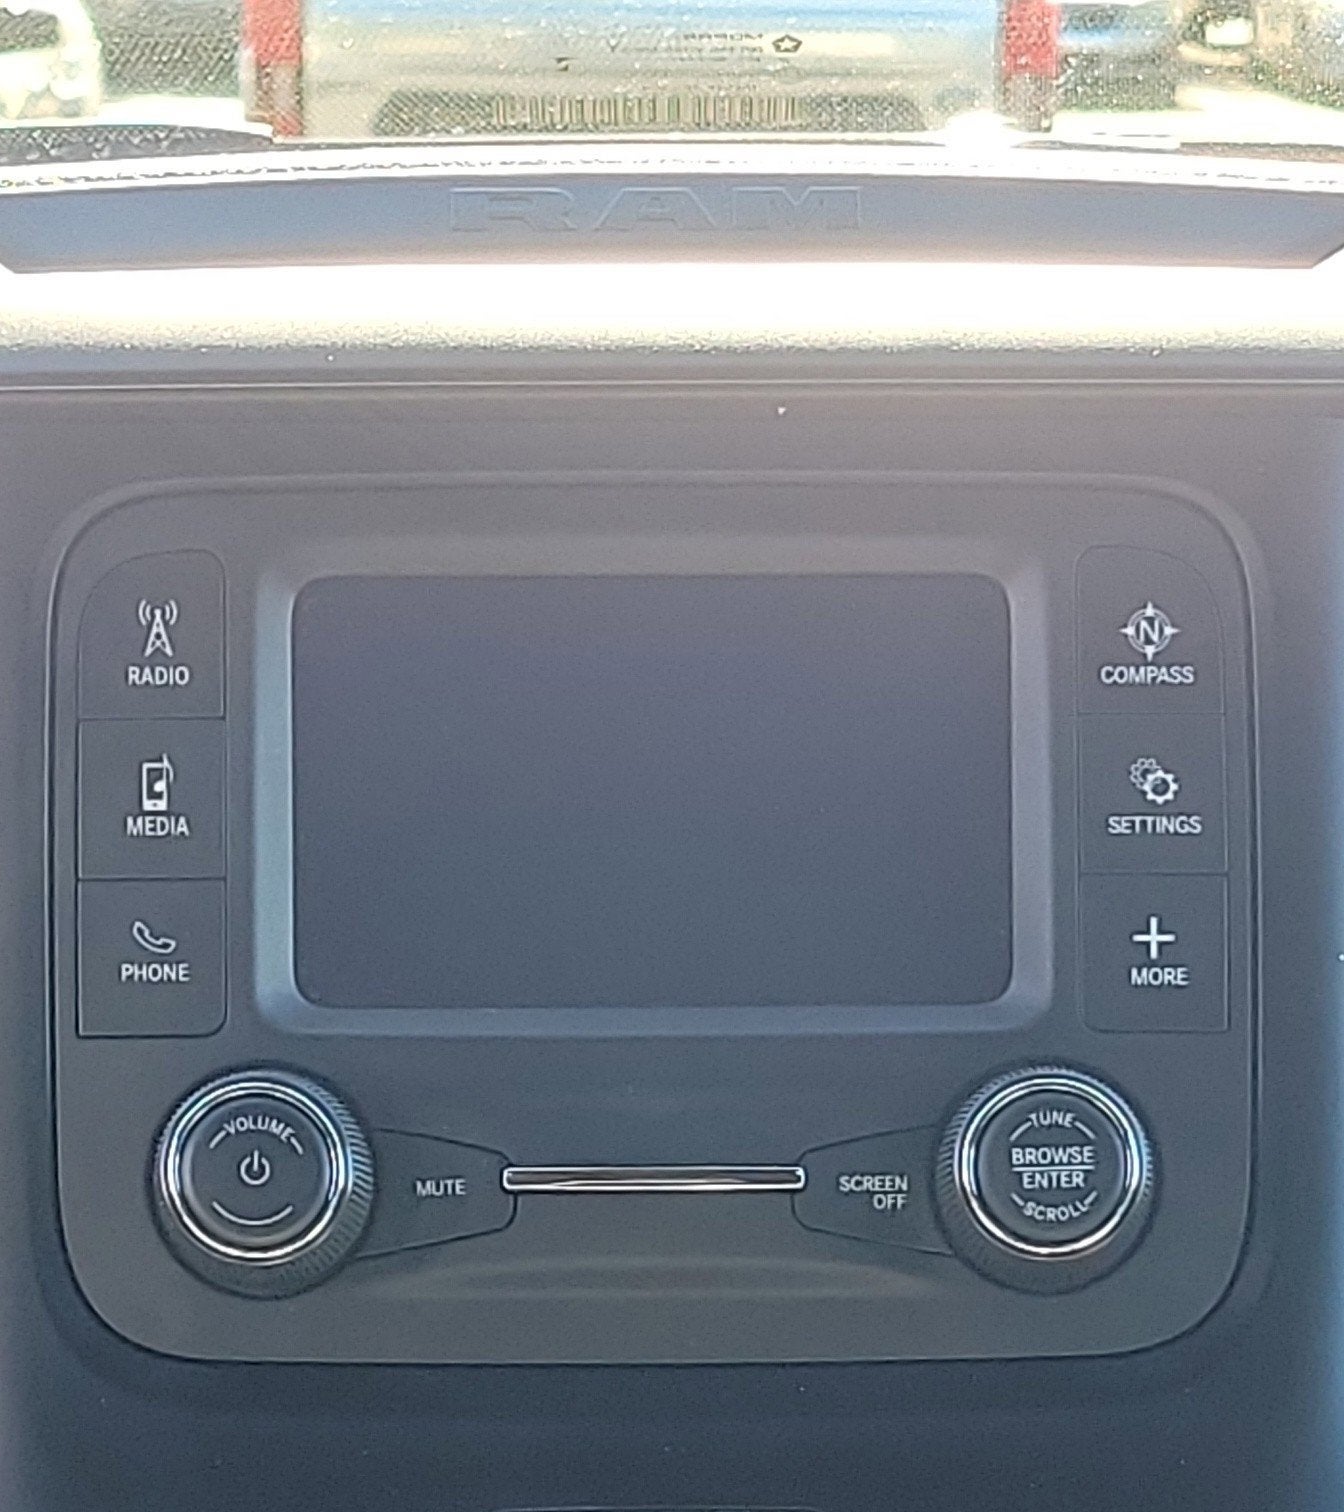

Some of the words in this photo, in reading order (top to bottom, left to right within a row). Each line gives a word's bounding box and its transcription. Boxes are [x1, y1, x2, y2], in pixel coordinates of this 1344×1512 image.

[450, 186, 860, 232] RAM
[1139, 619, 1159, 644] N
[127, 665, 190, 686] RADIO
[1100, 665, 1195, 685] COMPASS
[126, 815, 190, 837] MEDIA
[1108, 815, 1202, 835] SETTINGS
[120, 963, 192, 983] PHONE
[1130, 966, 1190, 986] MORE
[223, 1116, 296, 1143] VOLUME
[1029, 1110, 1076, 1129] TUNE
[1011, 1146, 1095, 1165] BROWSE
[415, 1178, 467, 1197] MUTE
[839, 1174, 908, 1192] SCREEN
[1022, 1171, 1085, 1189] ENTER
[873, 1193, 907, 1210] OFF
[1023, 1200, 1089, 1223] SCROLL
